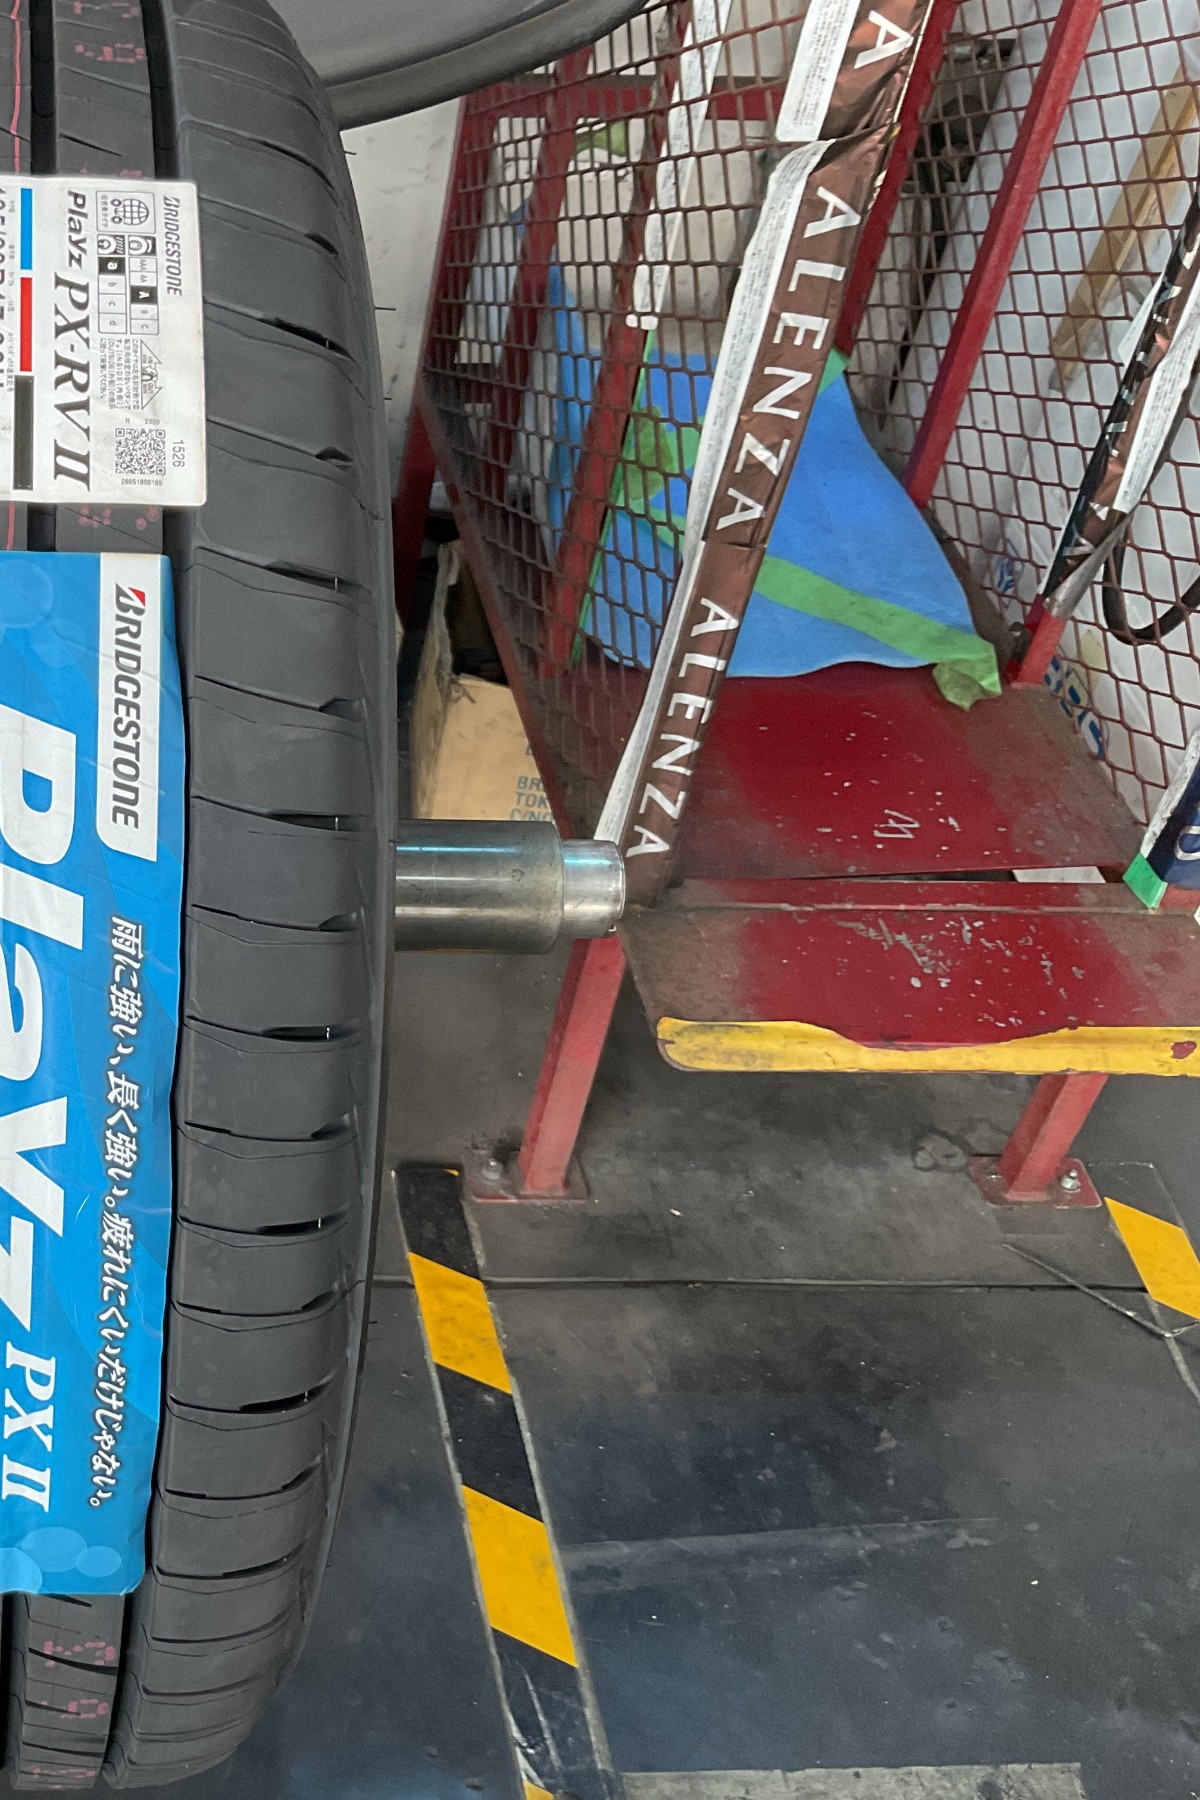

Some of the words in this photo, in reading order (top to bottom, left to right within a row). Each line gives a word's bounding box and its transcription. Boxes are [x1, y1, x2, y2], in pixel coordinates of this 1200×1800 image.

[67, 190, 88, 271] Playz
[107, 262, 118, 270] a
[163, 195, 182, 297] BRIDGESTONE
[139, 291, 149, 299] A
[53, 272, 90, 442] PX-RV
[715, 186, 861, 532] ALENZA
[172, 440, 185, 467] 1526
[111, 583, 146, 828] BRIDGESTONE
[625, 596, 740, 858] ALENZA
[3, 1341, 56, 1452] PX
